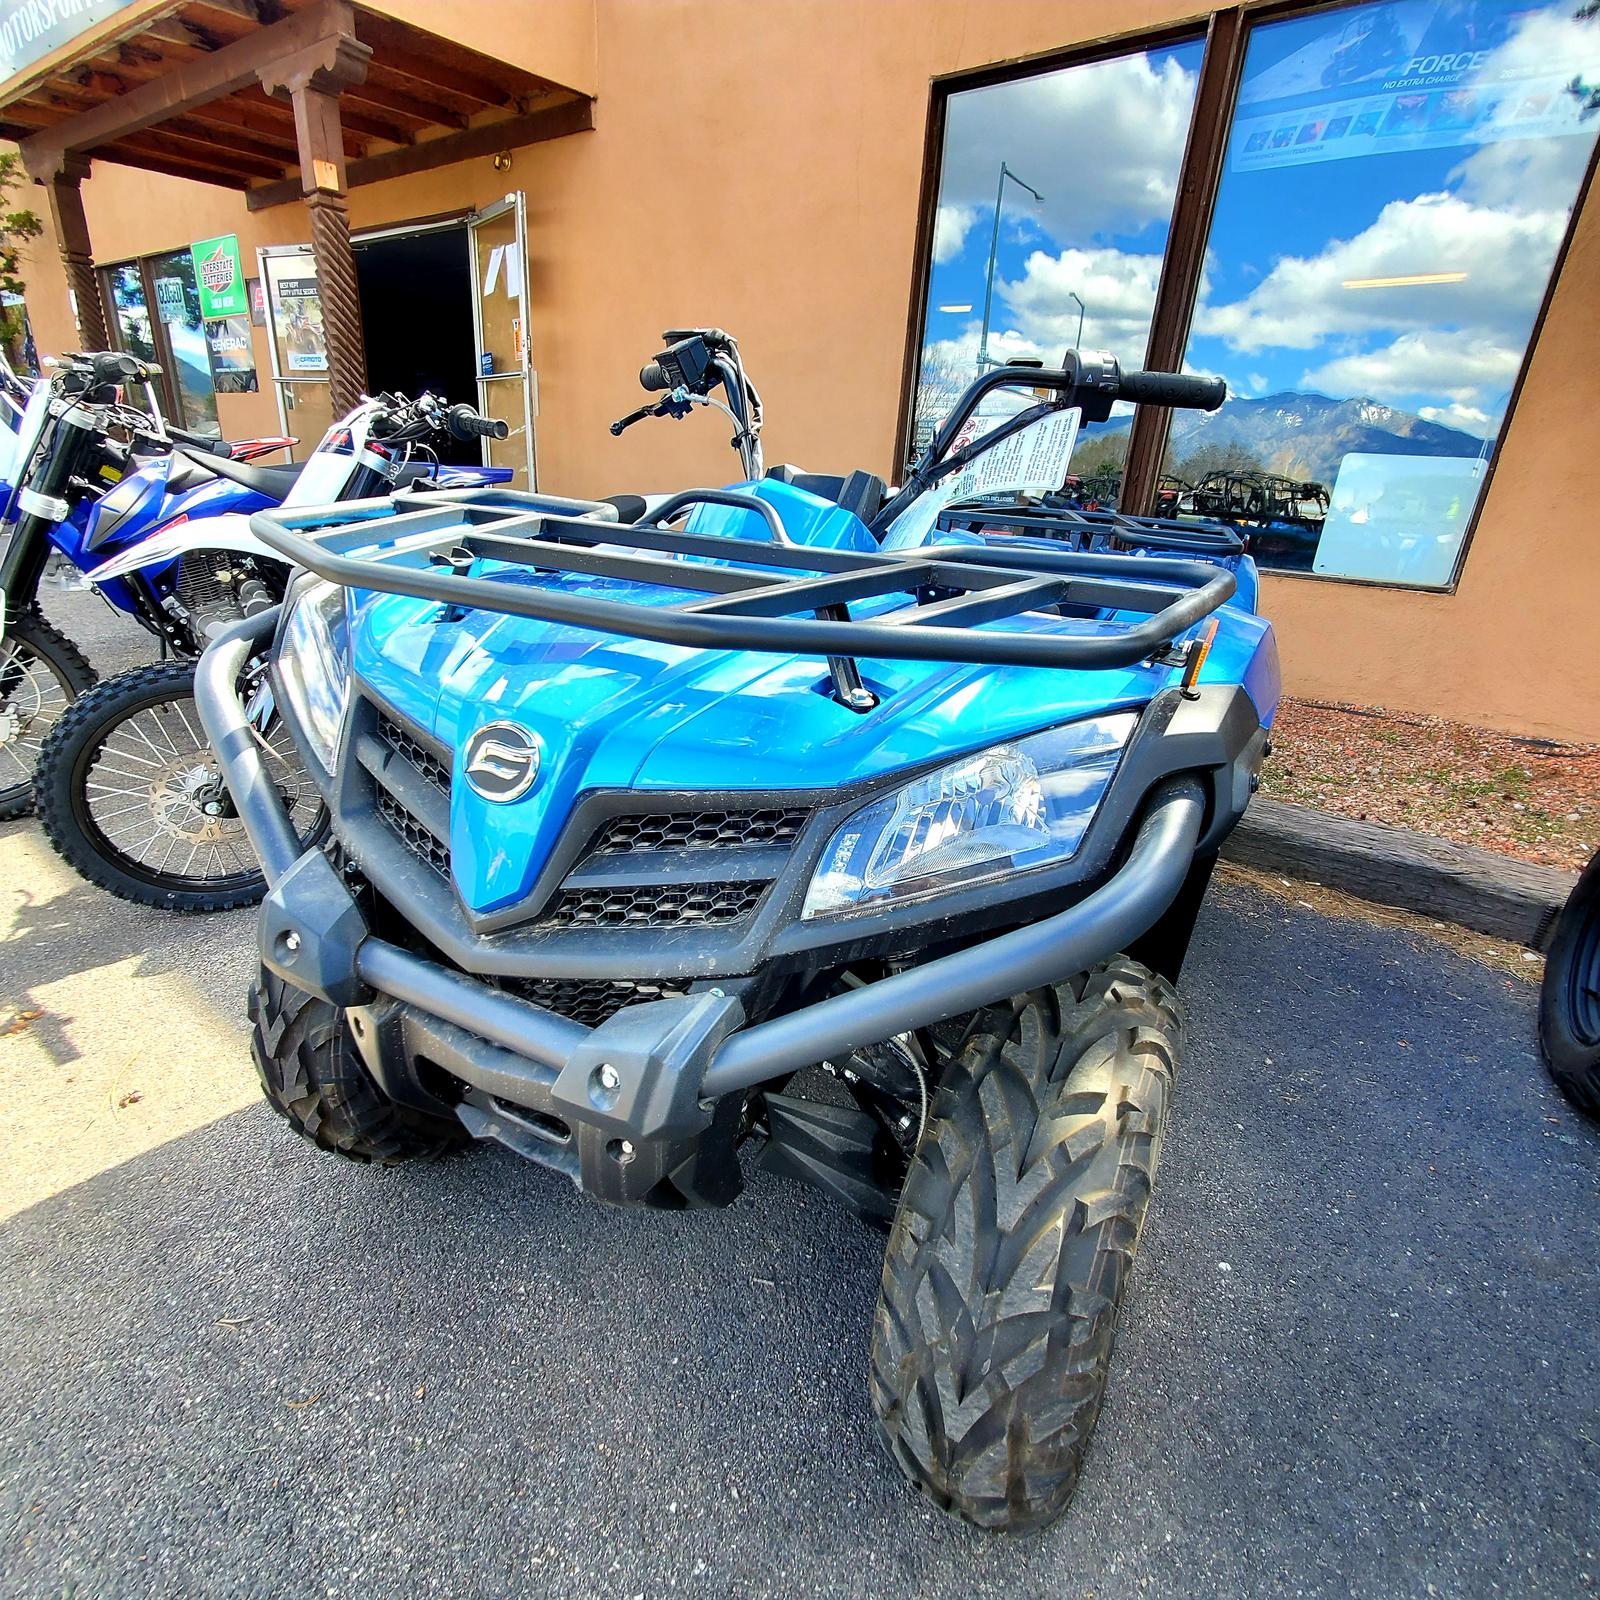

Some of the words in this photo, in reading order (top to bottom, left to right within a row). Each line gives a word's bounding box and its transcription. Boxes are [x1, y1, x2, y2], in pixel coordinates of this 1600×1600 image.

[0, 0, 104, 60] OTORSPO
[1402, 51, 1486, 76] FORCE
[1382, 80, 1397, 90] NO
[1397, 77, 1424, 87] EXTRA
[1425, 74, 1463, 85] CHARGE
[200, 259, 233, 274] INTERSTATE
[203, 271, 233, 285] BATTERIES
[212, 336, 248, 351] GENERAC
